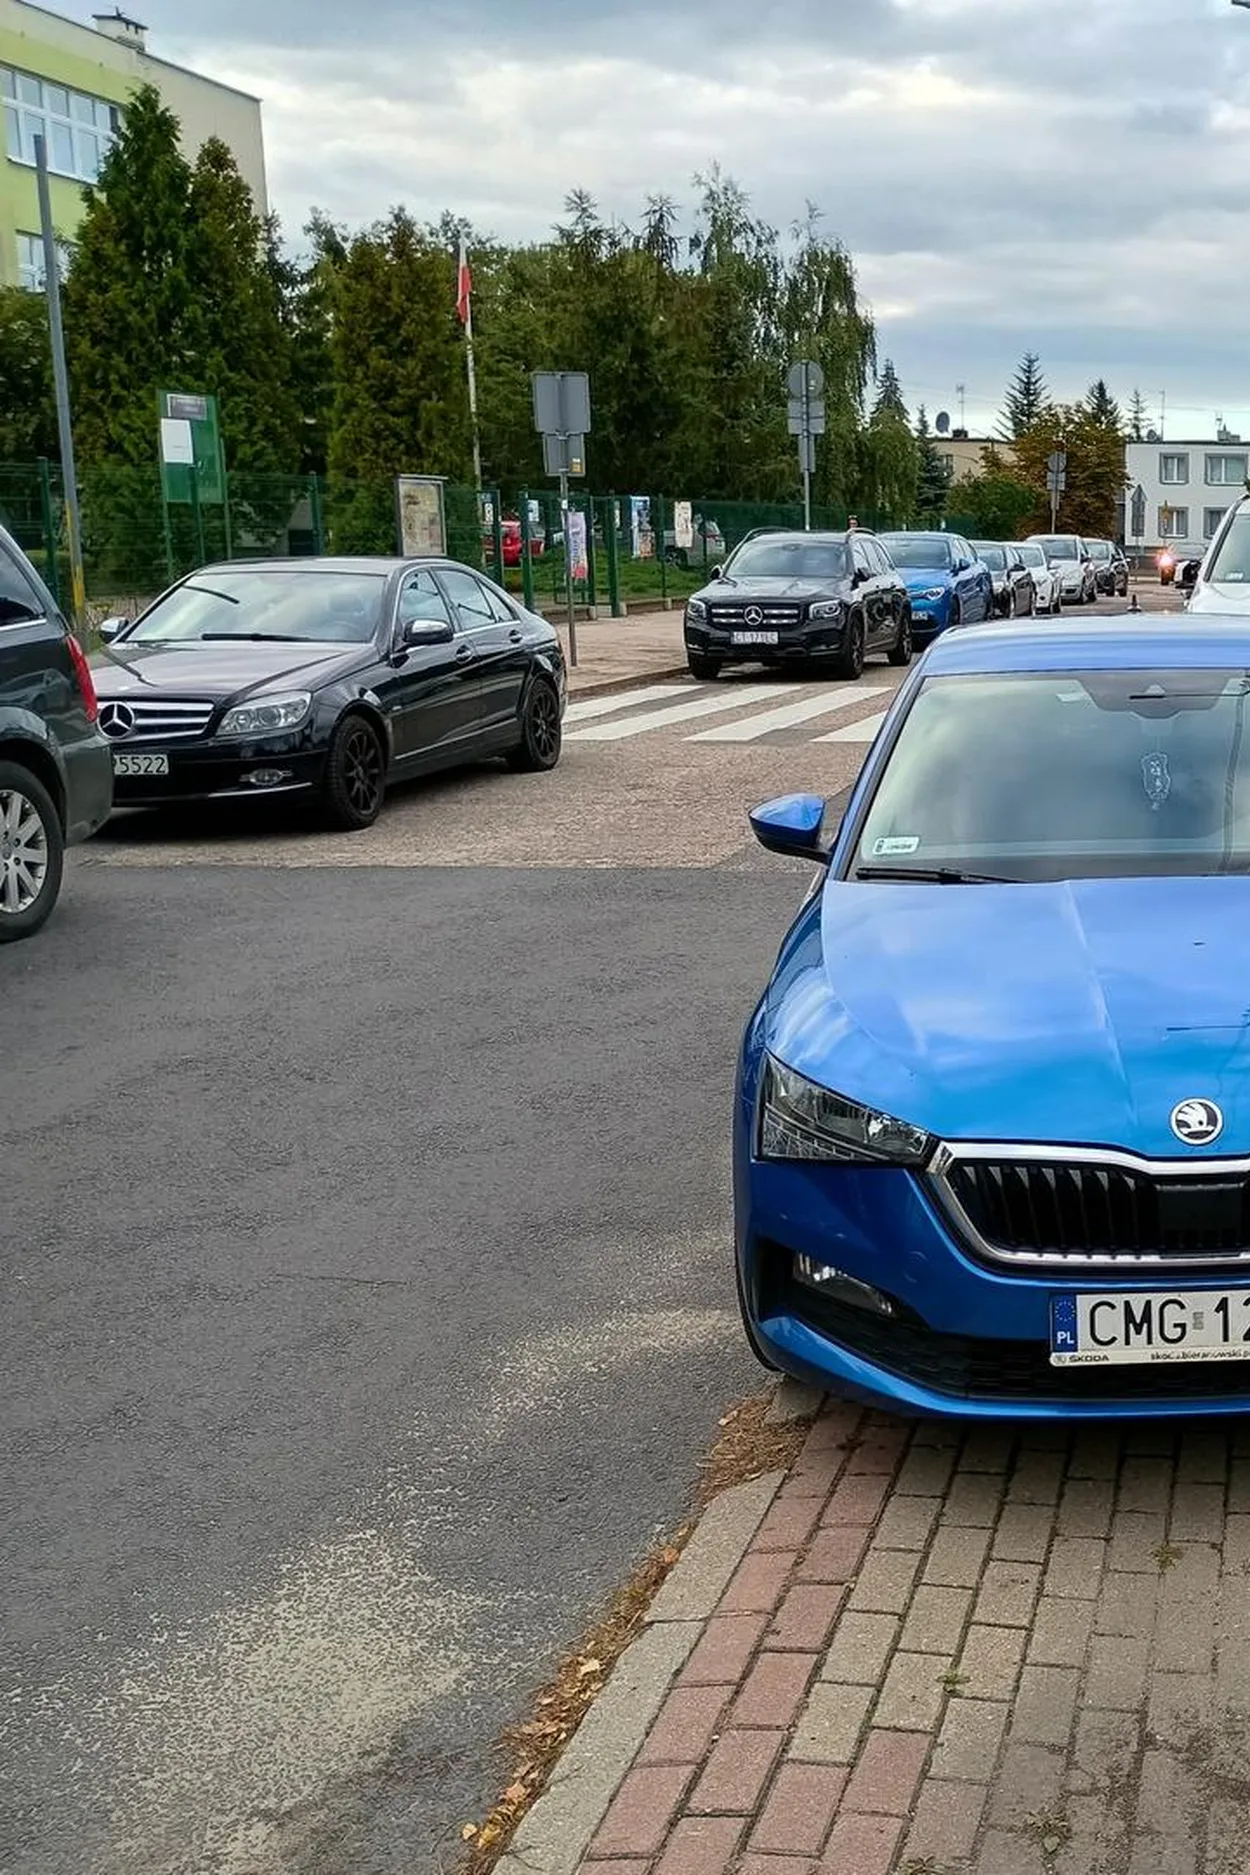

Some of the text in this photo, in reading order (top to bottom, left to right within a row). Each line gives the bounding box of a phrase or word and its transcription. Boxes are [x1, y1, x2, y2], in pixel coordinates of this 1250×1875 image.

[111, 756, 166, 774] 5522
[1089, 1298, 1187, 1347] CMG
[1056, 1330, 1075, 1345] PL
